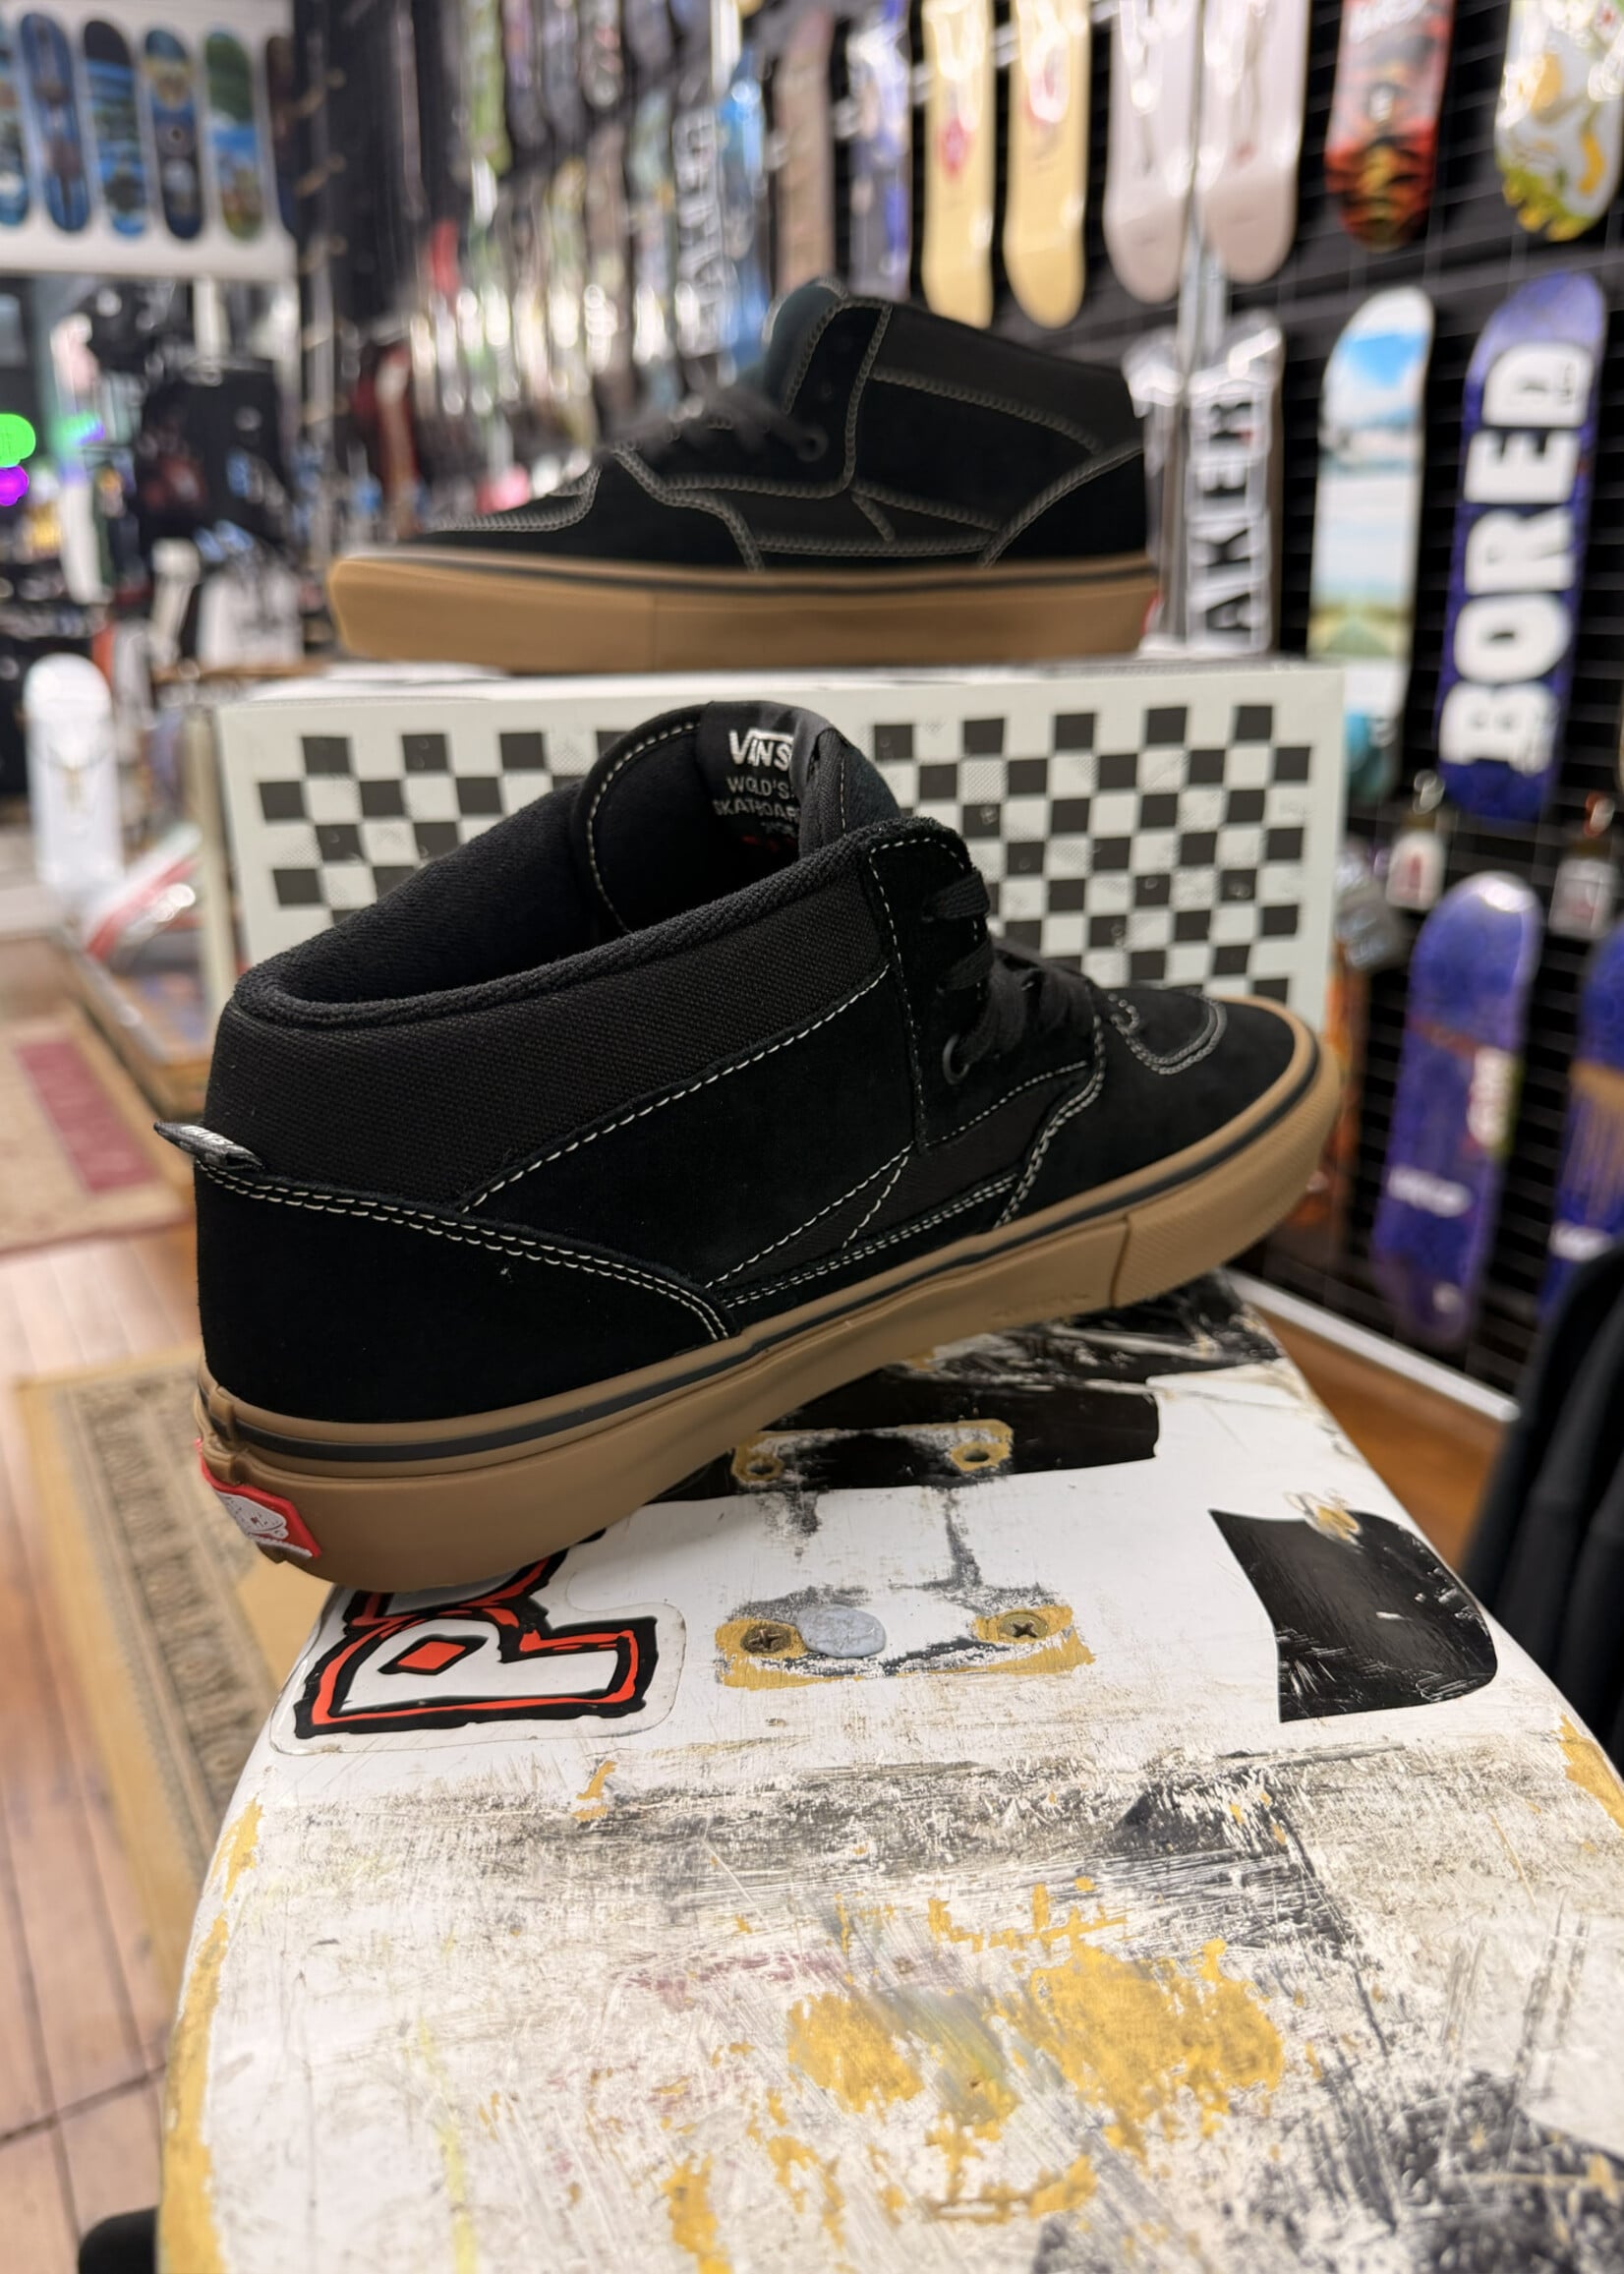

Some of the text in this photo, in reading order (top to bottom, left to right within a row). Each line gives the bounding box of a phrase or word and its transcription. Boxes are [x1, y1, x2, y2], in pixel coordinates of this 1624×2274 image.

[1195, 393, 1264, 646] AKER
[1438, 341, 1595, 769] BORED
[726, 776, 789, 799] WOLD'S
